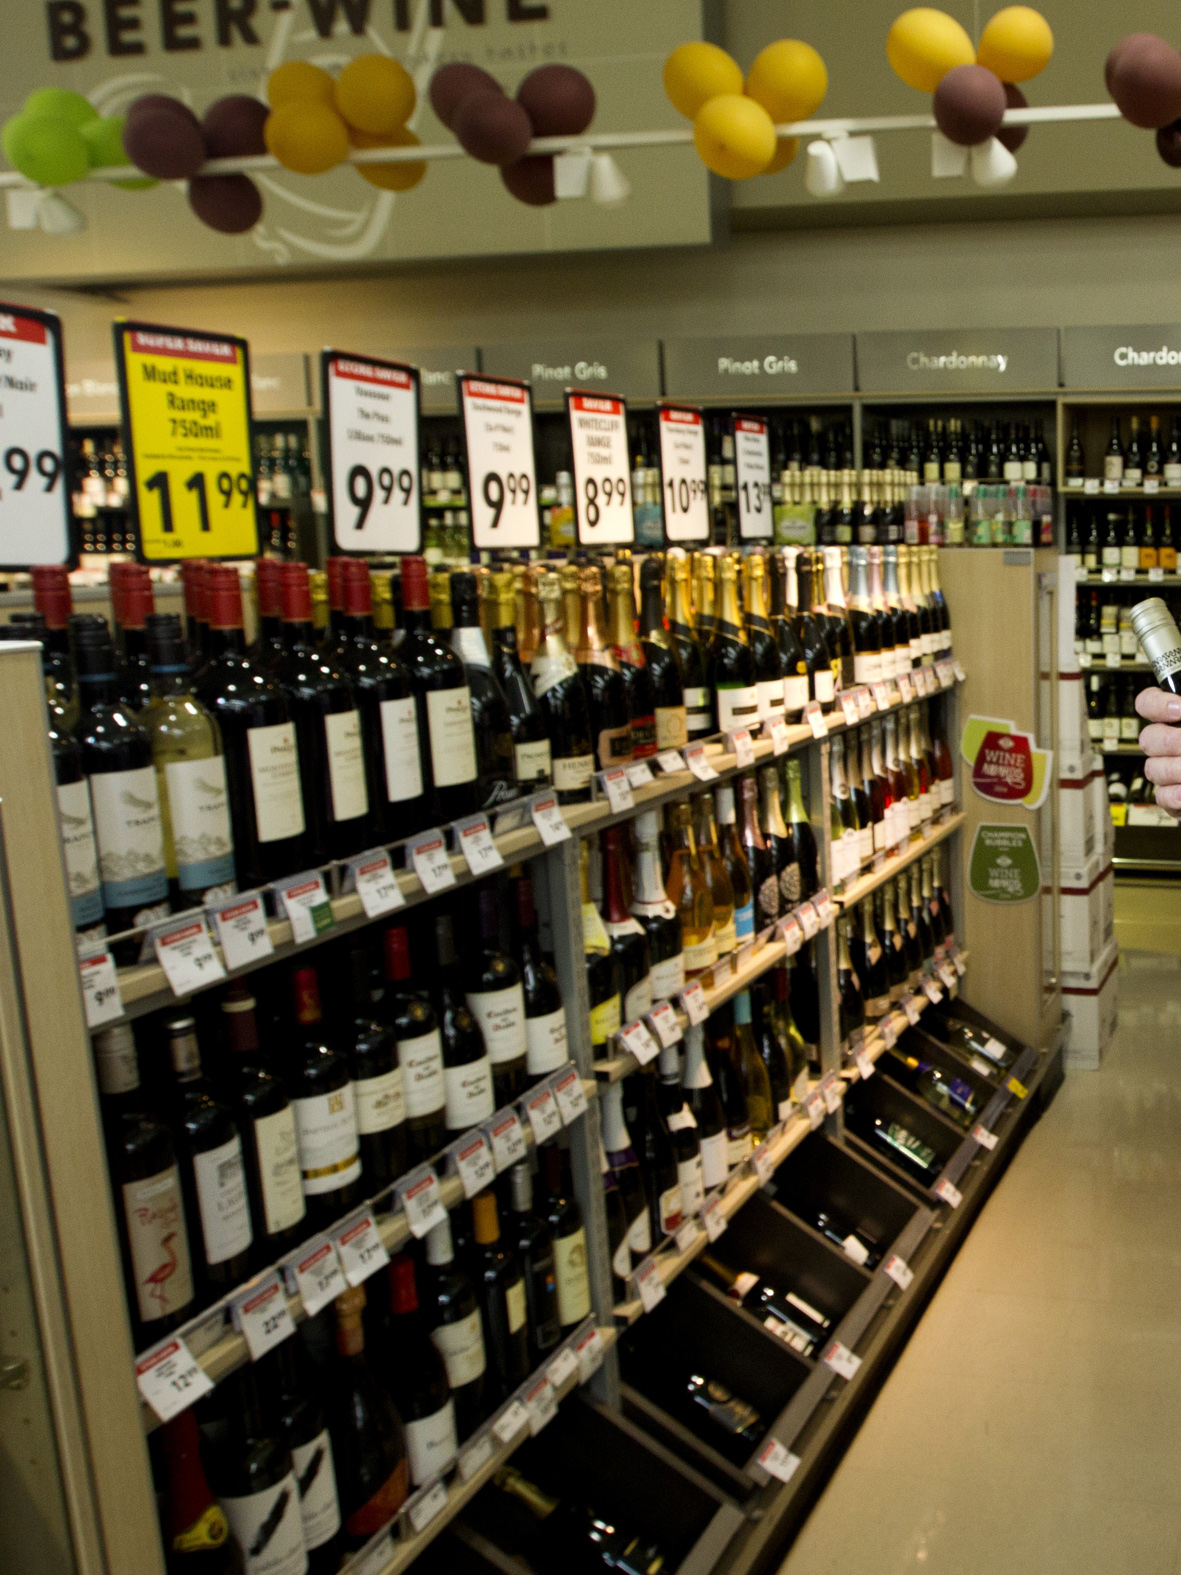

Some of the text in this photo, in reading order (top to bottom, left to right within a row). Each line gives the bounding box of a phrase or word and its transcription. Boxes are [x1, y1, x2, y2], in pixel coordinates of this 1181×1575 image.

[532, 361, 608, 382] Pinot Gris
[717, 355, 798, 375] Pinot Gris
[906, 350, 1008, 372] Chardonnay
[141, 363, 179, 385] Mud
[183, 367, 233, 391] House
[166, 391, 217, 418] Range
[168, 417, 222, 439] 750ml
[984, 749, 1026, 768] WINE
